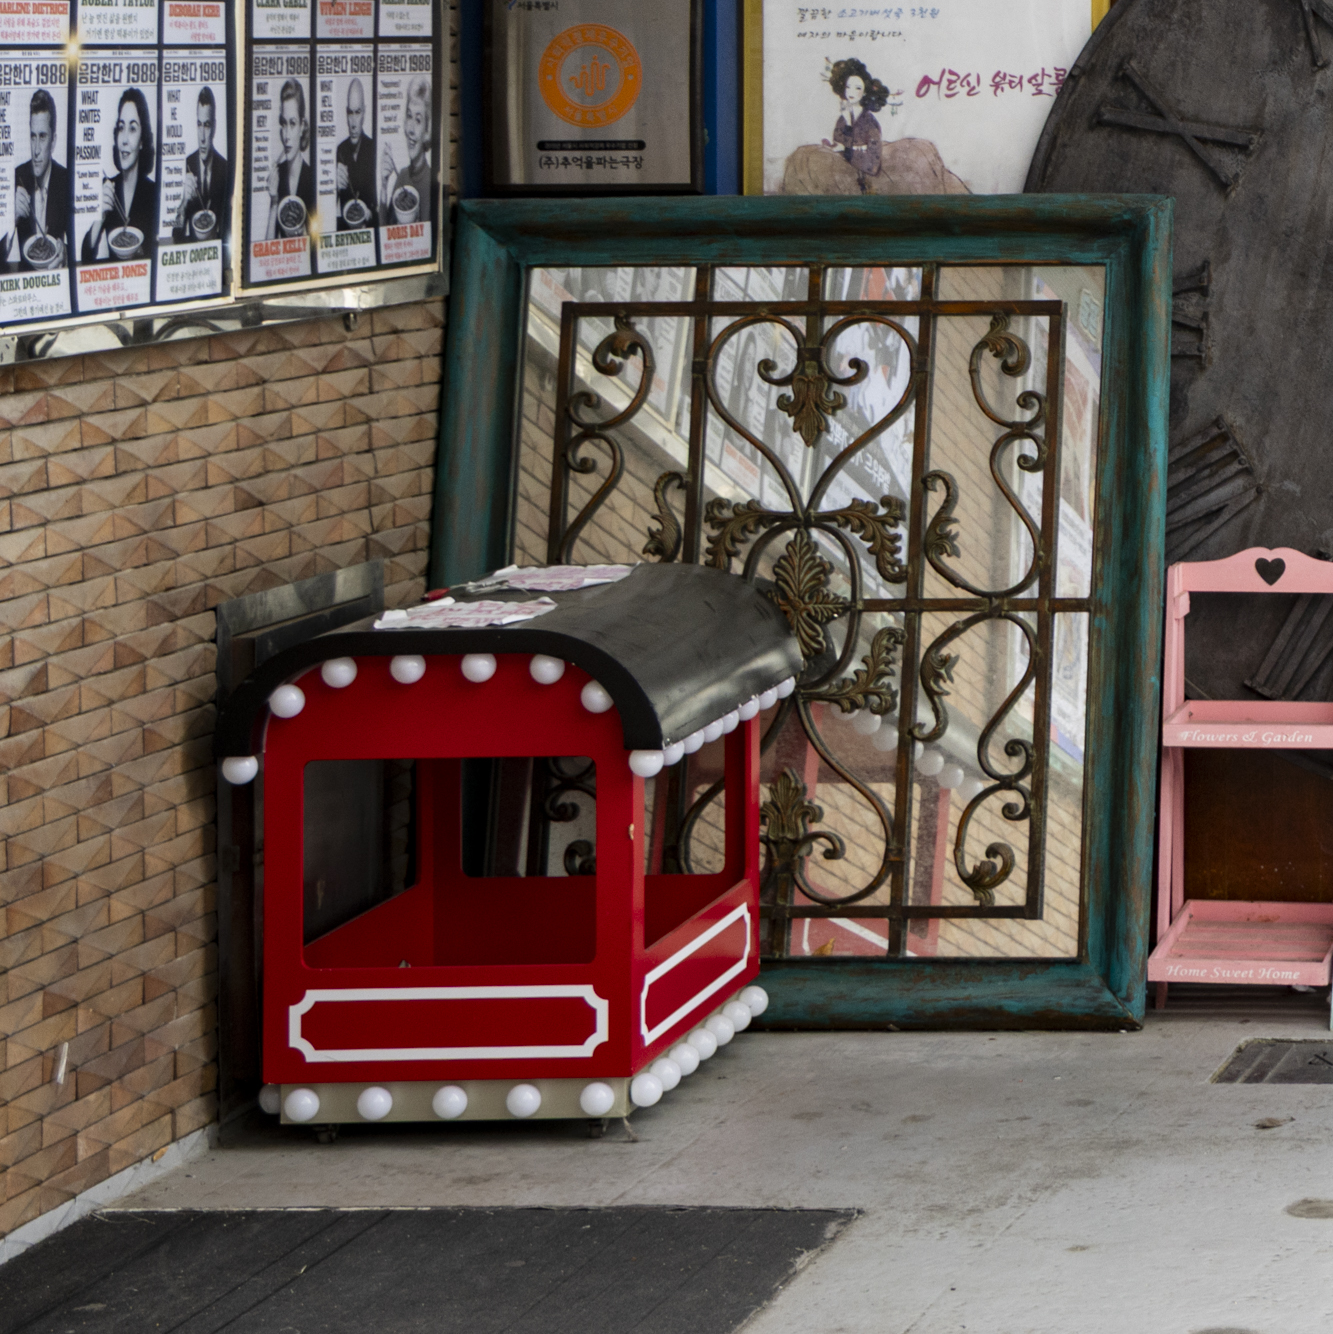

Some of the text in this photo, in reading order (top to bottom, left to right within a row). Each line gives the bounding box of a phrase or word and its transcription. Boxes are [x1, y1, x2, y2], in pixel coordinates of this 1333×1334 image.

[78, 62, 157, 84] 응답한다 1988
[916, 68, 981, 100] 어르신
[161, 246, 219, 266] GARY COOPER
[1180, 730, 1239, 743] Flowers
[1262, 731, 1313, 746] Garden
[1166, 965, 1301, 980] Home Sweet Home
